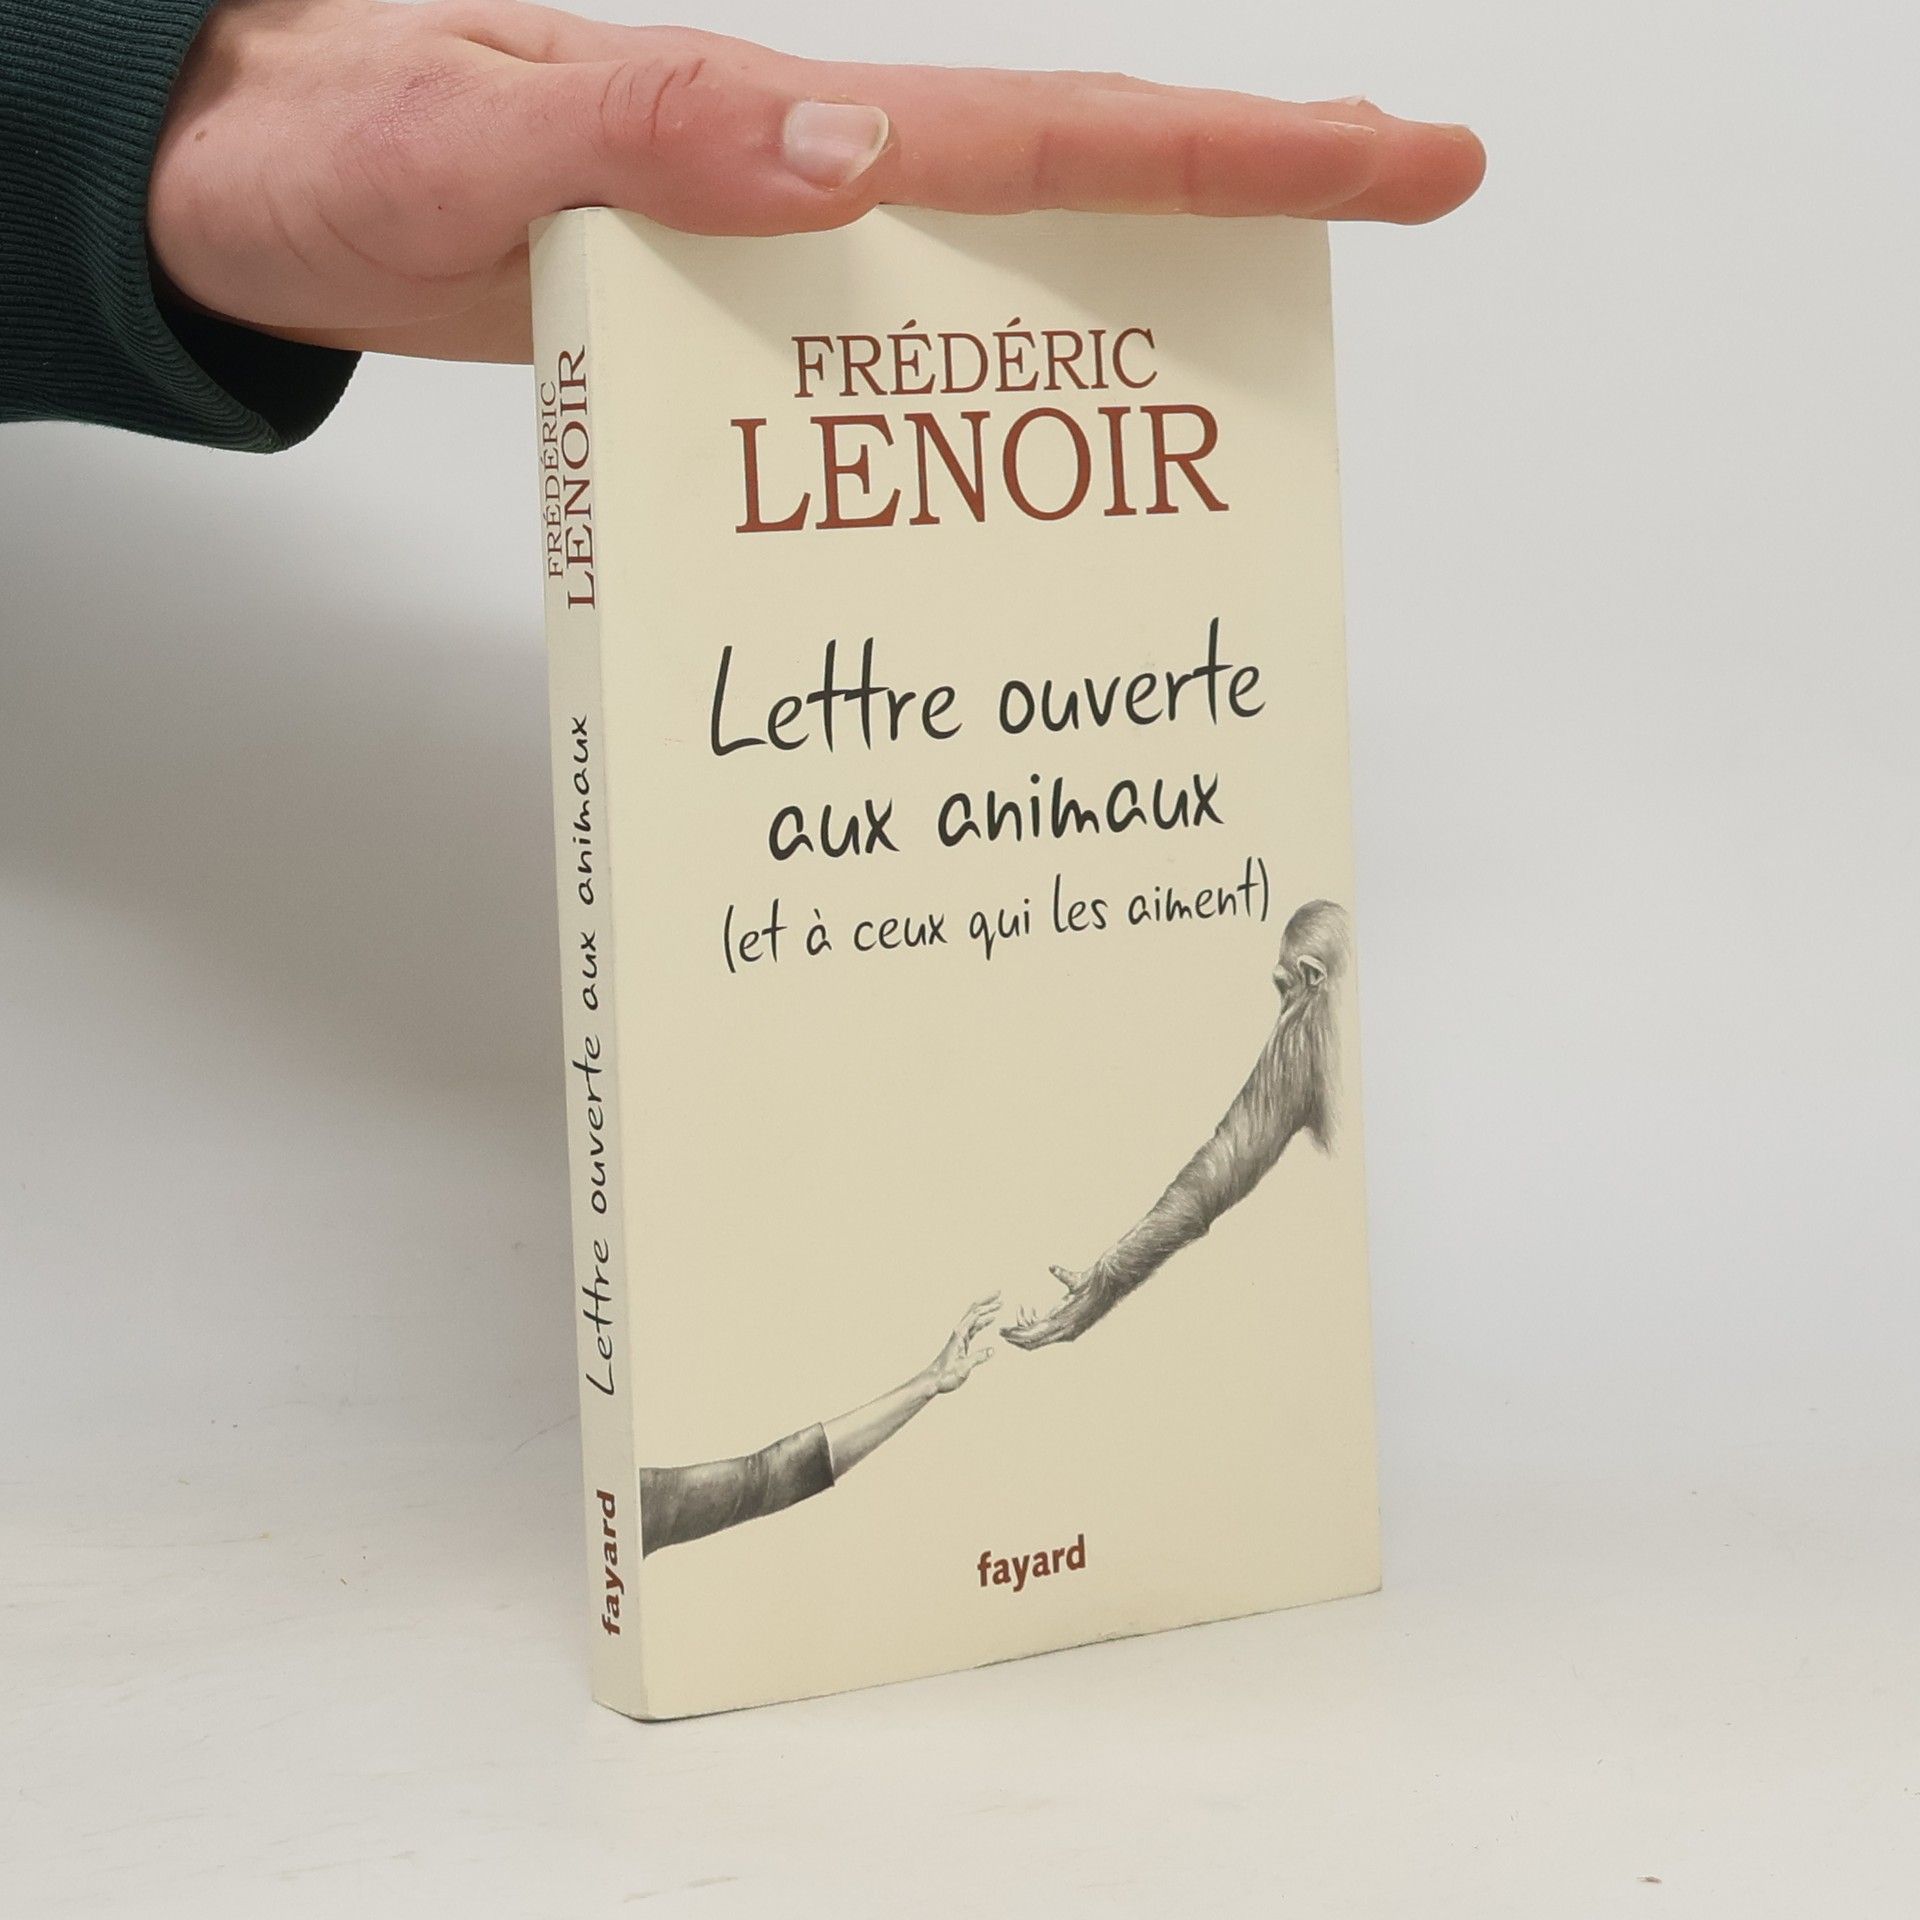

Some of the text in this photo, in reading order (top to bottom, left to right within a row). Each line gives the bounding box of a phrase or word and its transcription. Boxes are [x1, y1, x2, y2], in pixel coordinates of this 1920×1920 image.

[791, 318, 1158, 398] FRÉDÉRIC
[540, 380, 564, 579] FRÉDÉRIC
[557, 344, 596, 611] LENOIR
[731, 403, 1230, 534] LENOIR
[710, 616, 1266, 757] Lettre ouverte
[768, 773, 1225, 860] aux animaux
[723, 856, 1269, 974] (et à ceux qui les aiment)
[571, 714, 615, 1396] Lettre ouverte aux animaux
[597, 1489, 625, 1636] fayard
[976, 1533, 1087, 1594] fayard
